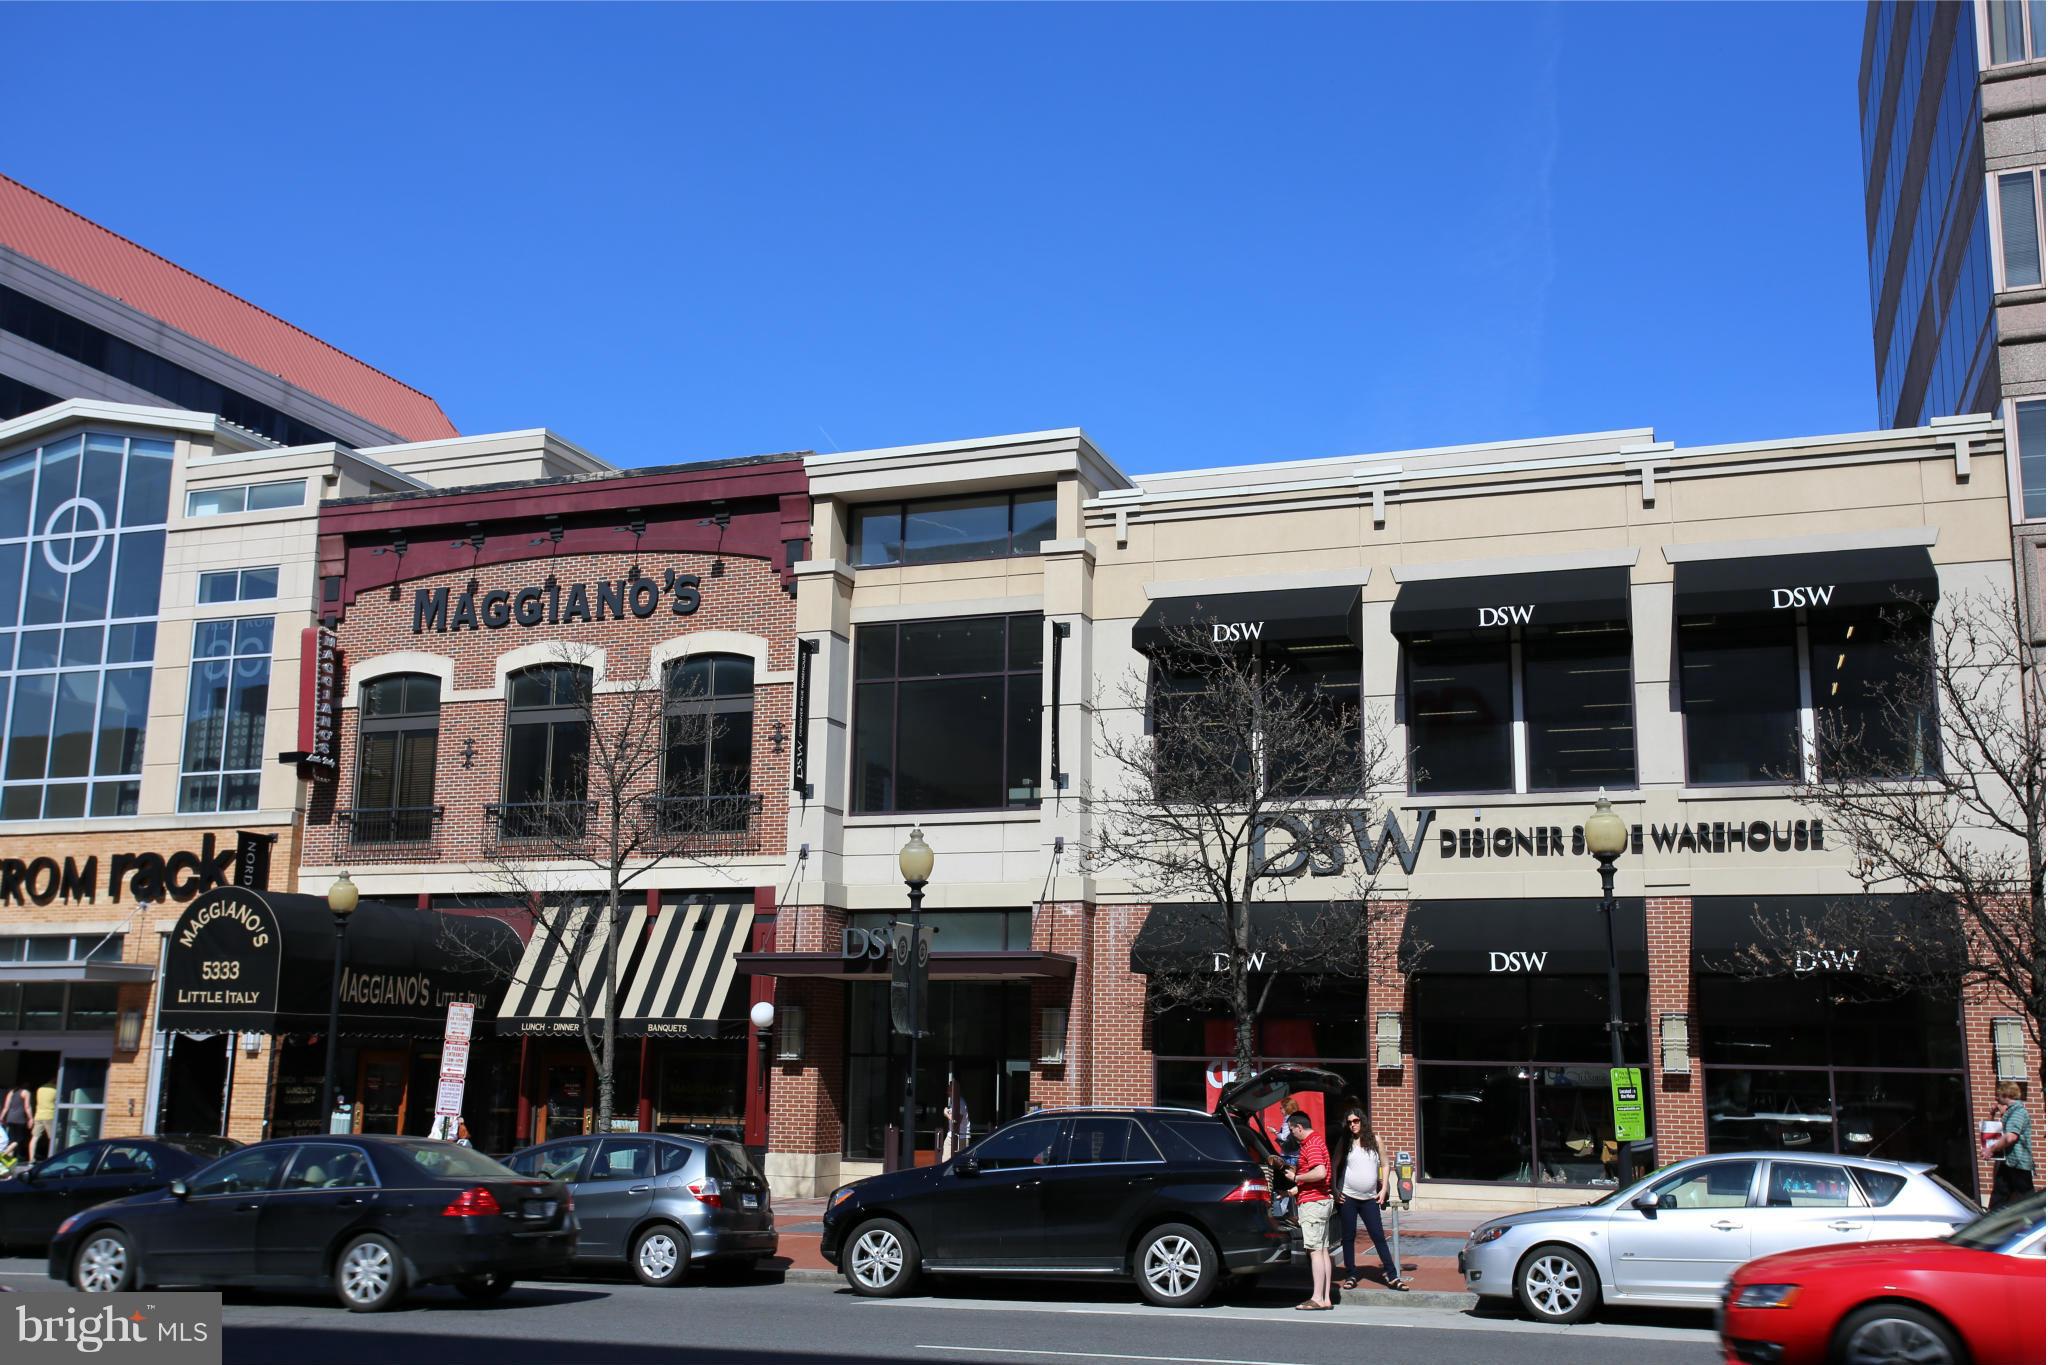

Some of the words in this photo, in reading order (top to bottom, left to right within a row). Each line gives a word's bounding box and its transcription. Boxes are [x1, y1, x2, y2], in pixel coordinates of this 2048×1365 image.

[412, 568, 701, 634] MAGGIANO'S
[1772, 586, 1835, 609] DSW
[1479, 605, 1535, 627] DSW
[1212, 622, 1264, 642] DSW
[796, 740, 804, 779] DSW
[1250, 808, 1436, 876] DSW
[1440, 826, 1564, 858] DESIGNER
[1572, 824, 1643, 856] SE
[1651, 819, 1824, 853] WAREHOUSE
[0, 856, 98, 907] ROM
[108, 832, 237, 905] rack
[243, 841, 257, 886] NORD
[179, 899, 269, 949] MAGGIANO'S
[842, 928, 897, 960] DS
[202, 961, 240, 980] 5333
[1212, 952, 1267, 972] DW
[1489, 951, 1548, 973] DSW
[178, 989, 223, 1004] LITTLE
[225, 989, 260, 1004] ITALY
[521, 1022, 546, 1032] LUNCH
[553, 1022, 580, 1032] DINNER
[648, 1023, 687, 1033] BANQUETS
